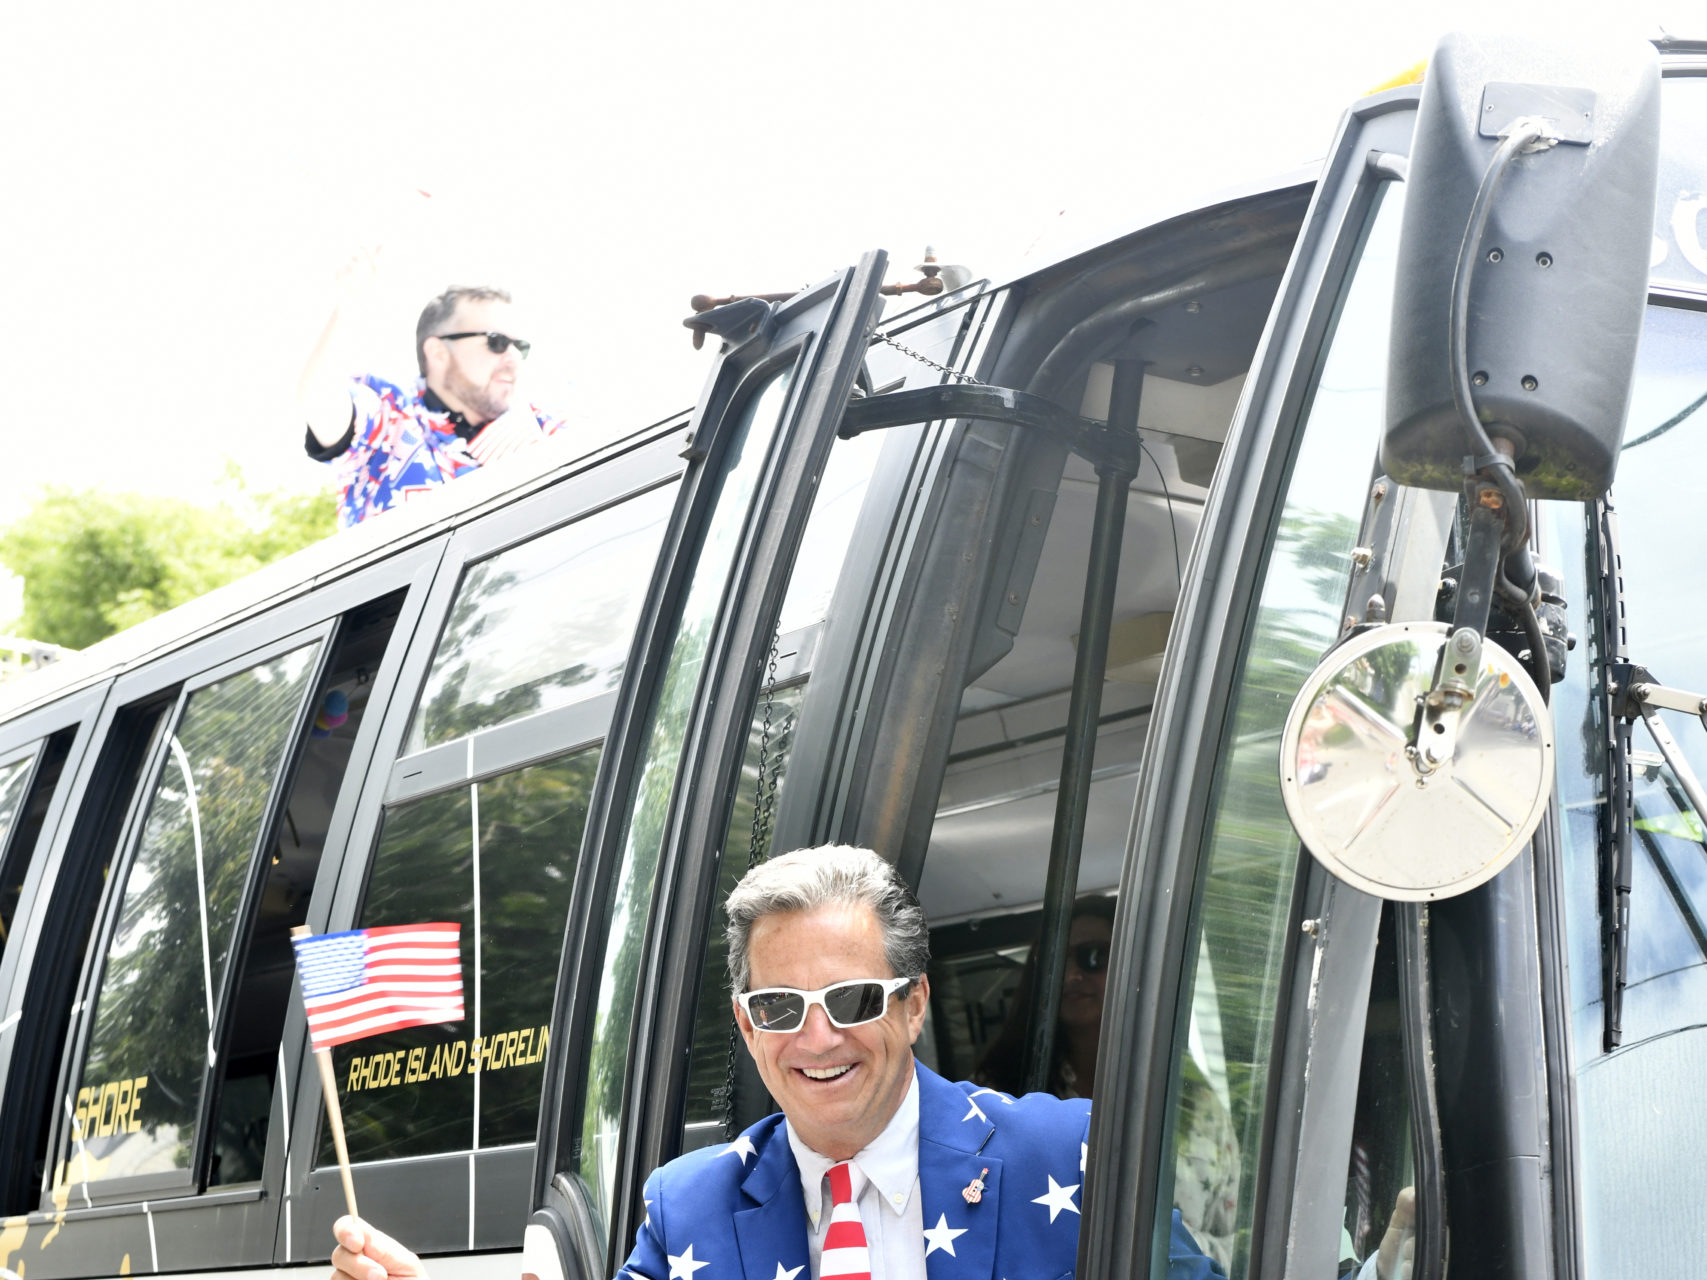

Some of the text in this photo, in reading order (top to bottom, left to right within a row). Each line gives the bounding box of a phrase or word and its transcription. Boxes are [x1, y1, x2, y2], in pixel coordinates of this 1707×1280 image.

[346, 1050, 406, 1092] RHODE
[404, 1040, 467, 1084] ISLAND
[72, 1076, 148, 1142] SHORE
